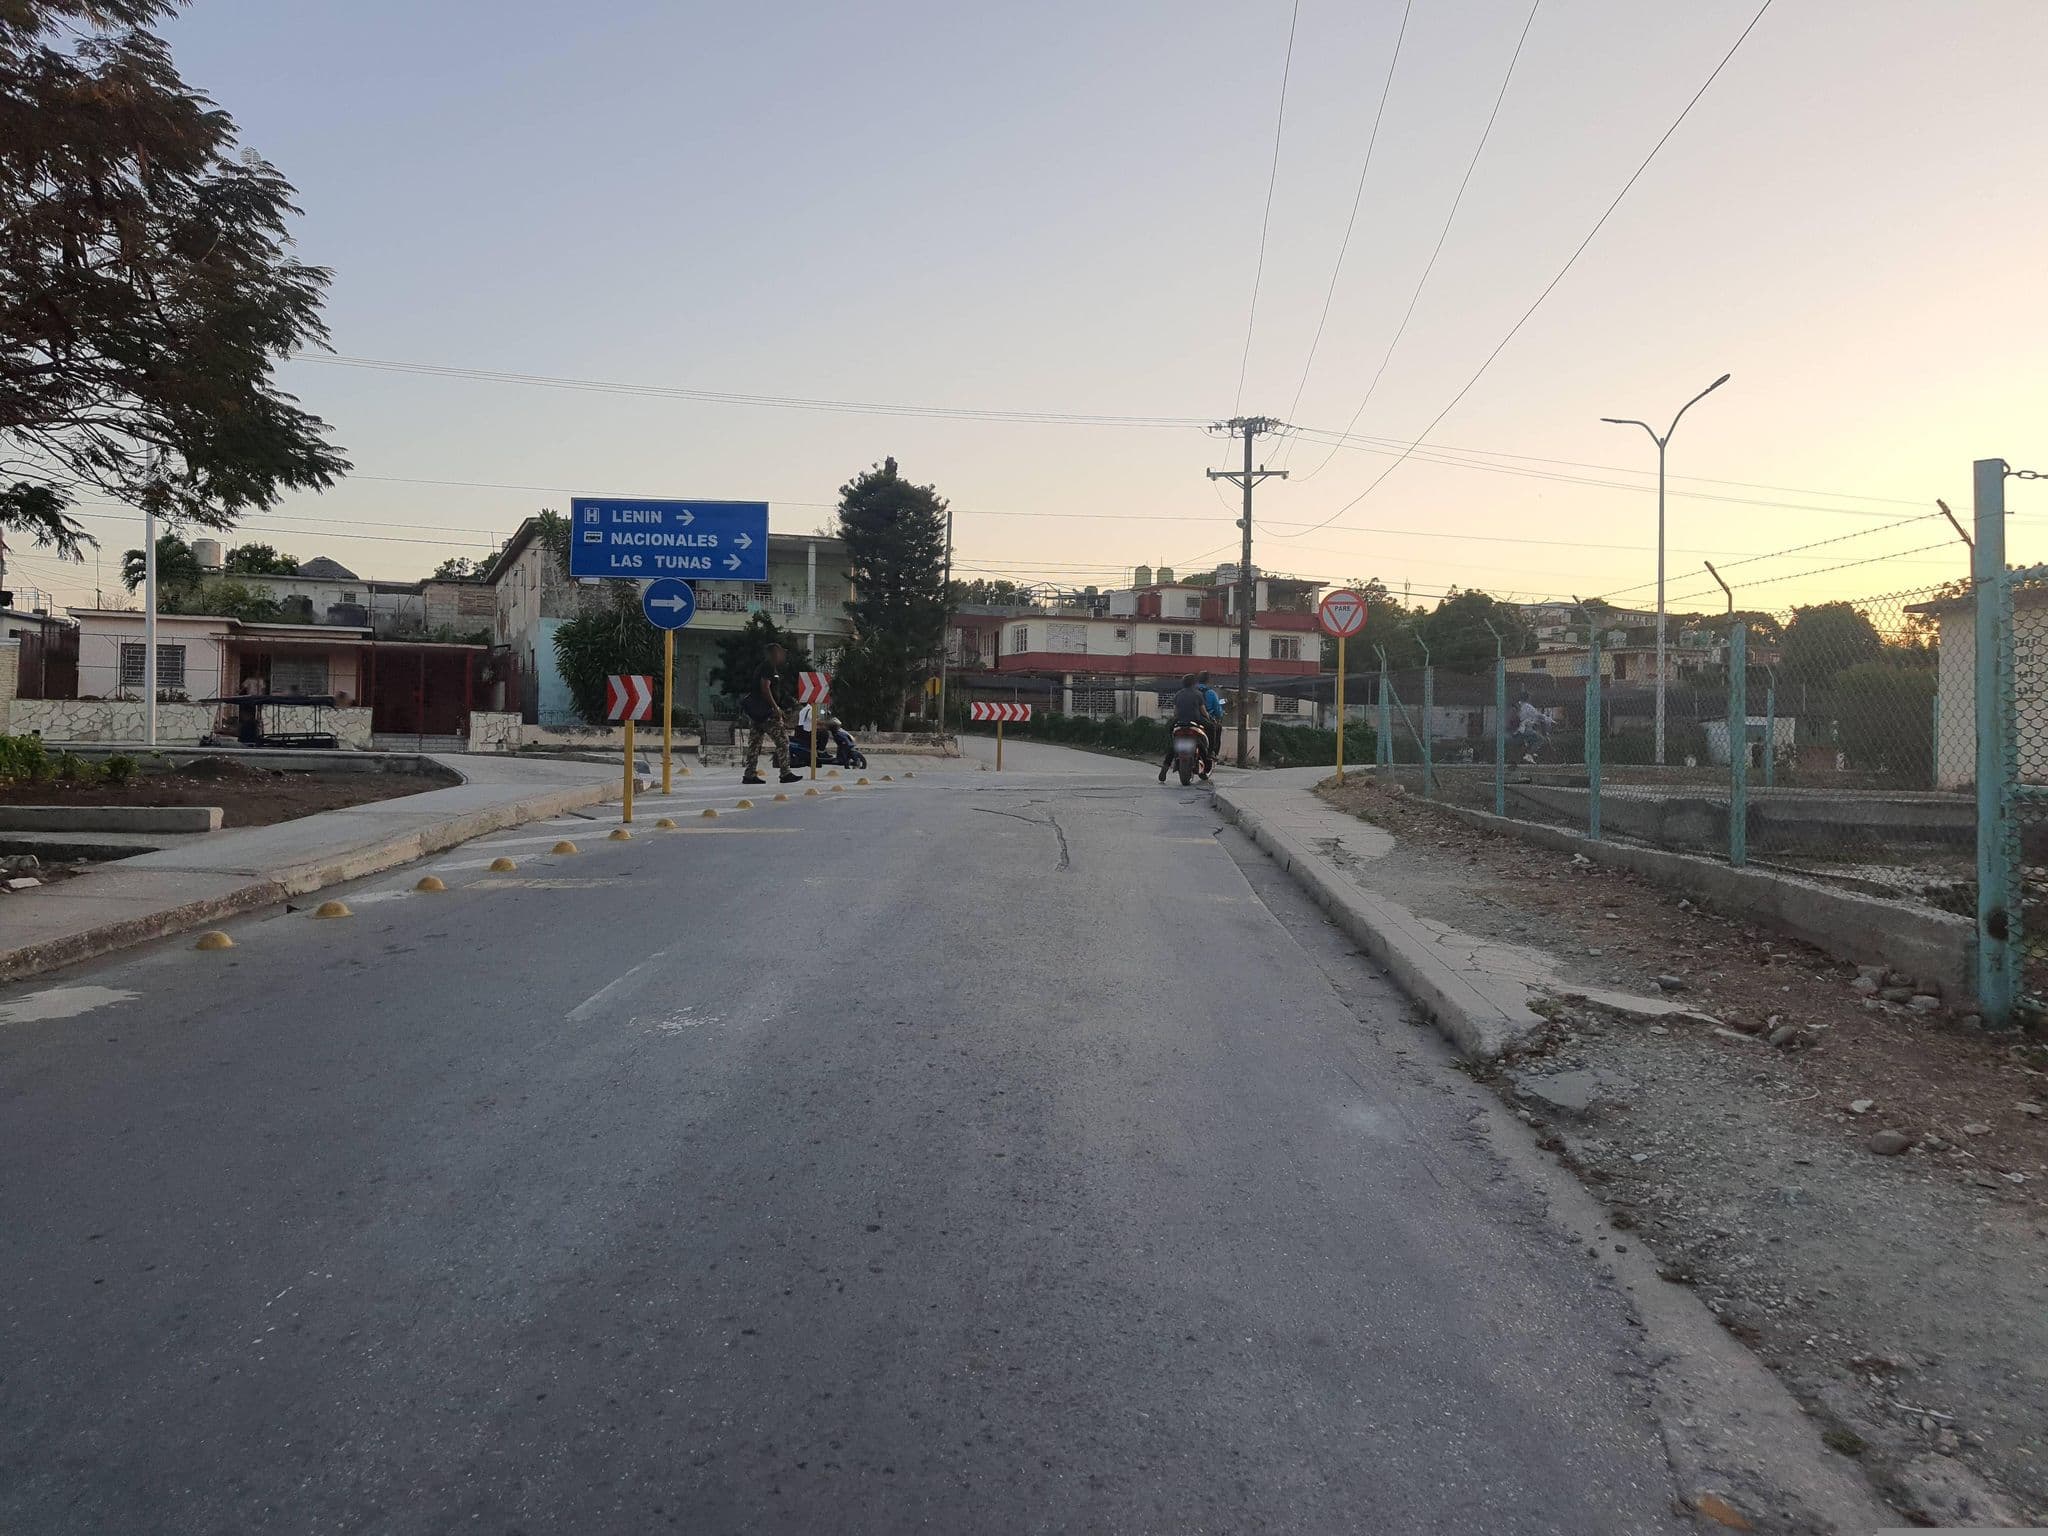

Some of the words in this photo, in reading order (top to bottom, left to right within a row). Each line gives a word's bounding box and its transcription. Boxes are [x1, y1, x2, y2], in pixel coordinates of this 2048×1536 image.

[612, 510, 662, 524] LENIN
[611, 532, 718, 547] NACIONALES
[611, 554, 642, 567] LAS
[655, 555, 712, 569] TUNAS
